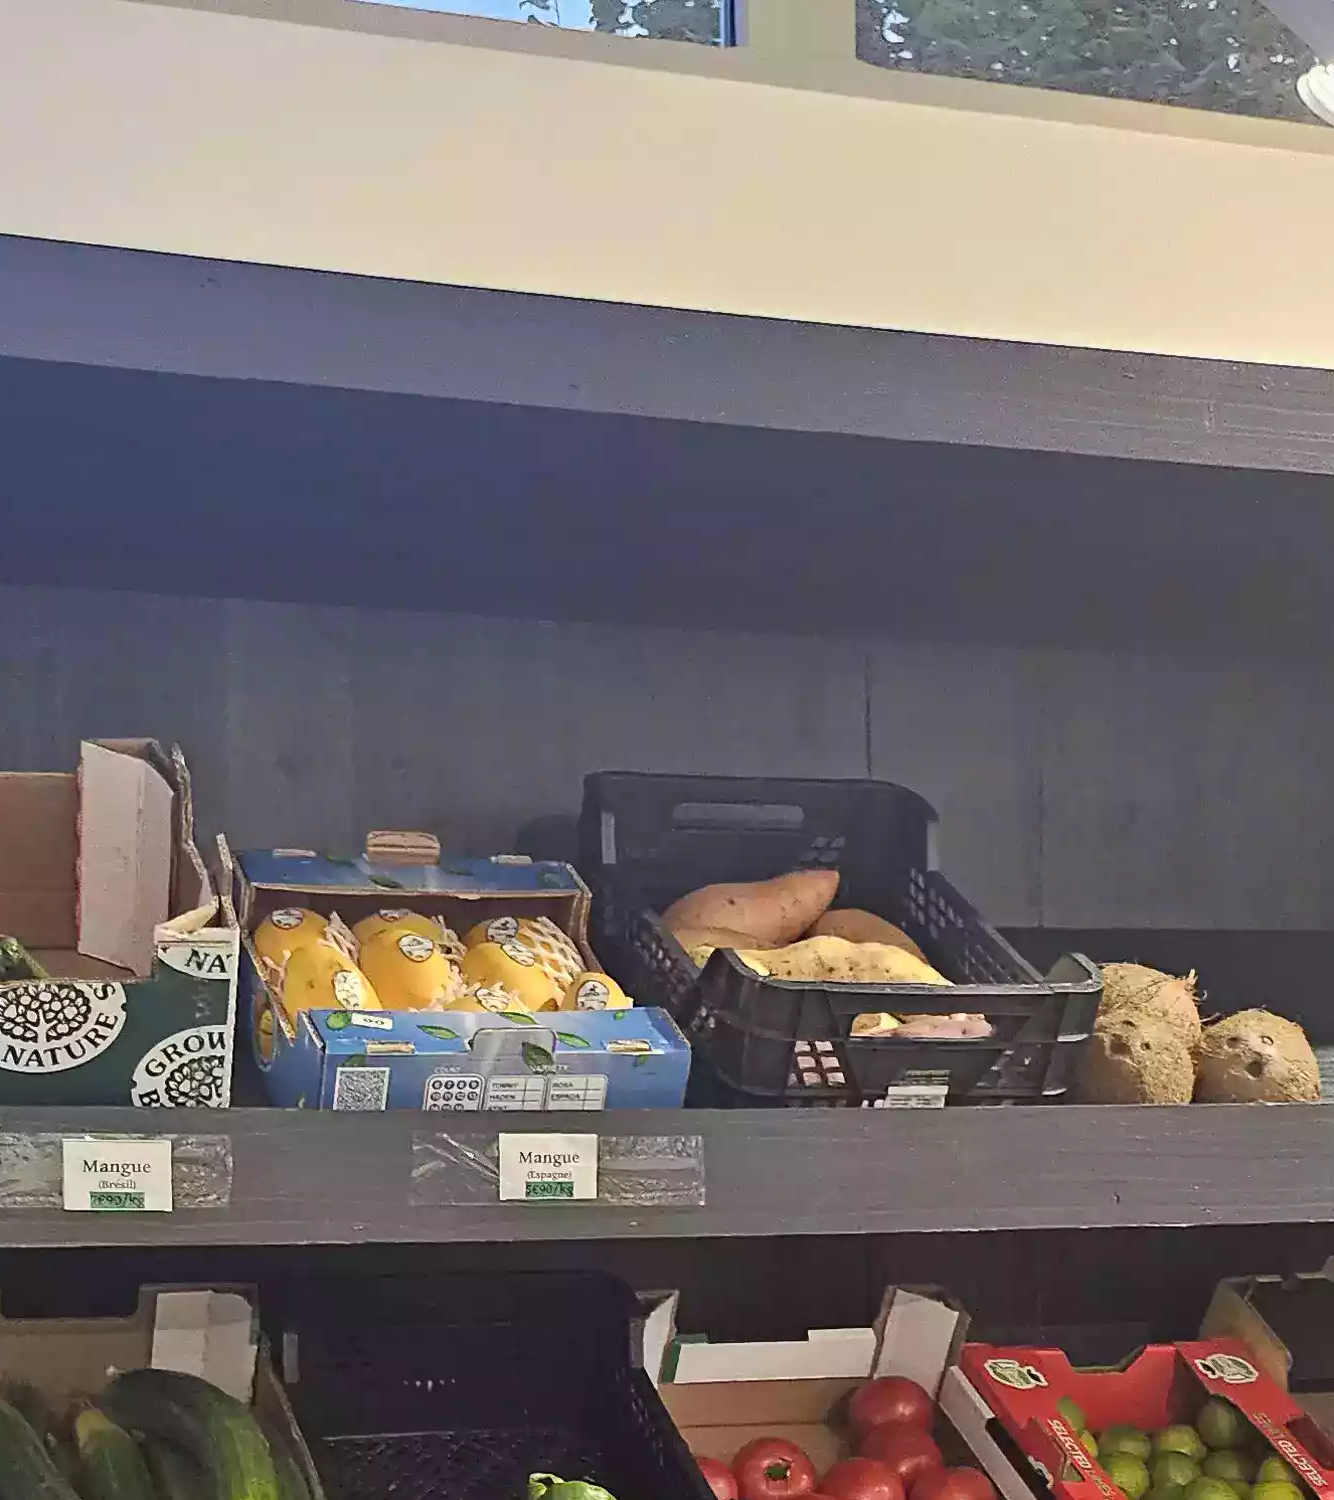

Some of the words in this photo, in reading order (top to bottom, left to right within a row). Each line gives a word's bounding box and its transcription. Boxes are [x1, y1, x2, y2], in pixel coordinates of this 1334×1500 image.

[1, 1012, 119, 1068] NATURE
[82, 1159, 153, 1178] Mangue
[518, 1151, 580, 1168] Mangue
[1047, 1418, 1093, 1470] SELECTED
[1277, 1439, 1329, 1487] SELECTED
